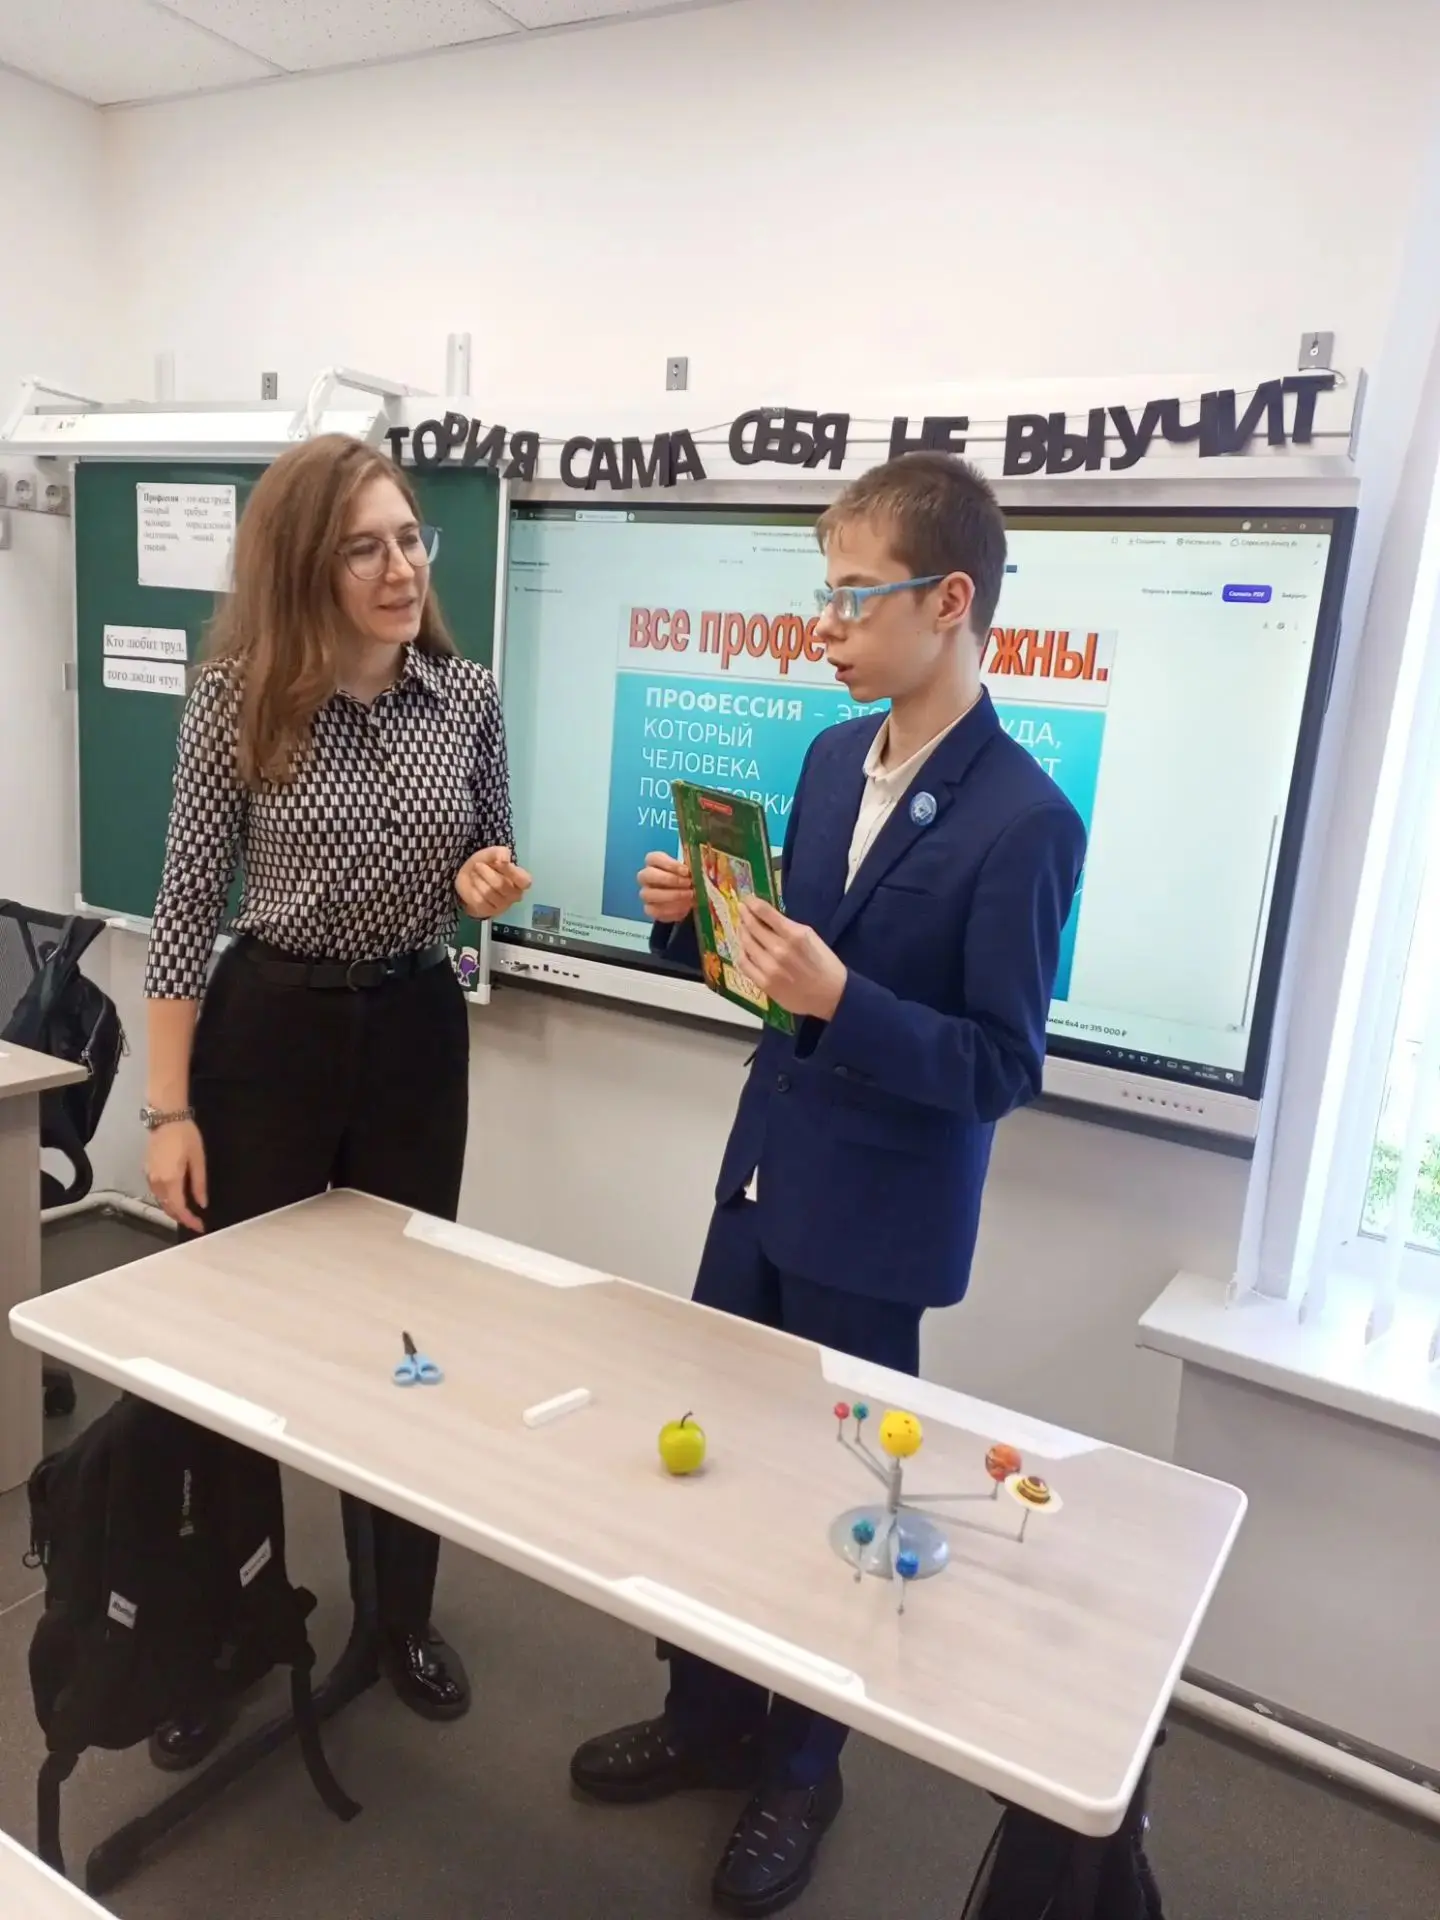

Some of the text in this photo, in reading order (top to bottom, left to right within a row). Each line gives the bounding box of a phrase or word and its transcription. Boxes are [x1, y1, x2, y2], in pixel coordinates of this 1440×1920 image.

[384, 374, 1336, 490] ТОРИЯ САМА СЕБЯ НЕ ВЫУЧИТ
[106, 634, 124, 648] Кто
[127, 637, 157, 651] любит
[698, 612, 825, 674] профе
[979, 627, 1108, 681] жны.
[107, 670, 127, 681] того
[131, 673, 155, 684] люди
[644, 717, 753, 748] КОТОРЫЙ
[646, 687, 802, 721] ПРОФЕССИЯ
[1000, 718, 1062, 748] УДА,
[641, 747, 761, 780] ЧЕЛОВЕКА
[637, 806, 679, 831] УМЕ
[1103, 1027, 1121, 1036] 000
